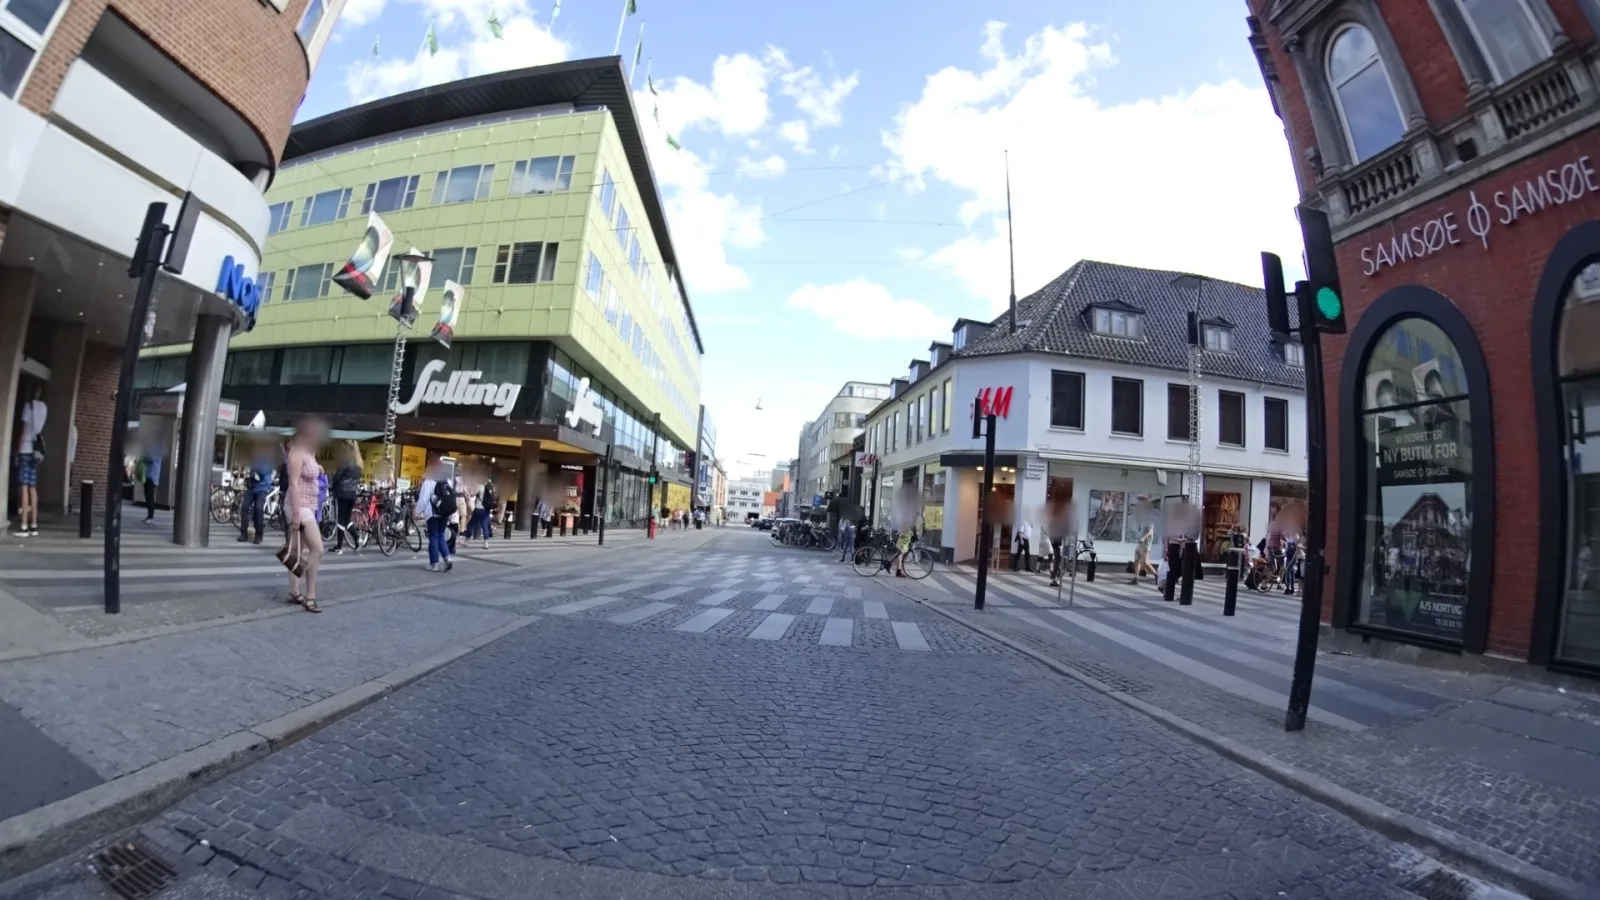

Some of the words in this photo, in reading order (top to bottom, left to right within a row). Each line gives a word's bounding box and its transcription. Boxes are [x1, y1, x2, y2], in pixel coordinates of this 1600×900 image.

[1361, 212, 1460, 275] SAMSØE
[1494, 155, 1600, 226] SAMSØE
[389, 359, 522, 417] Salling
[1383, 447, 1399, 463] NY
[1400, 444, 1433, 462] BUTIK
[1435, 441, 1459, 459] FOR
